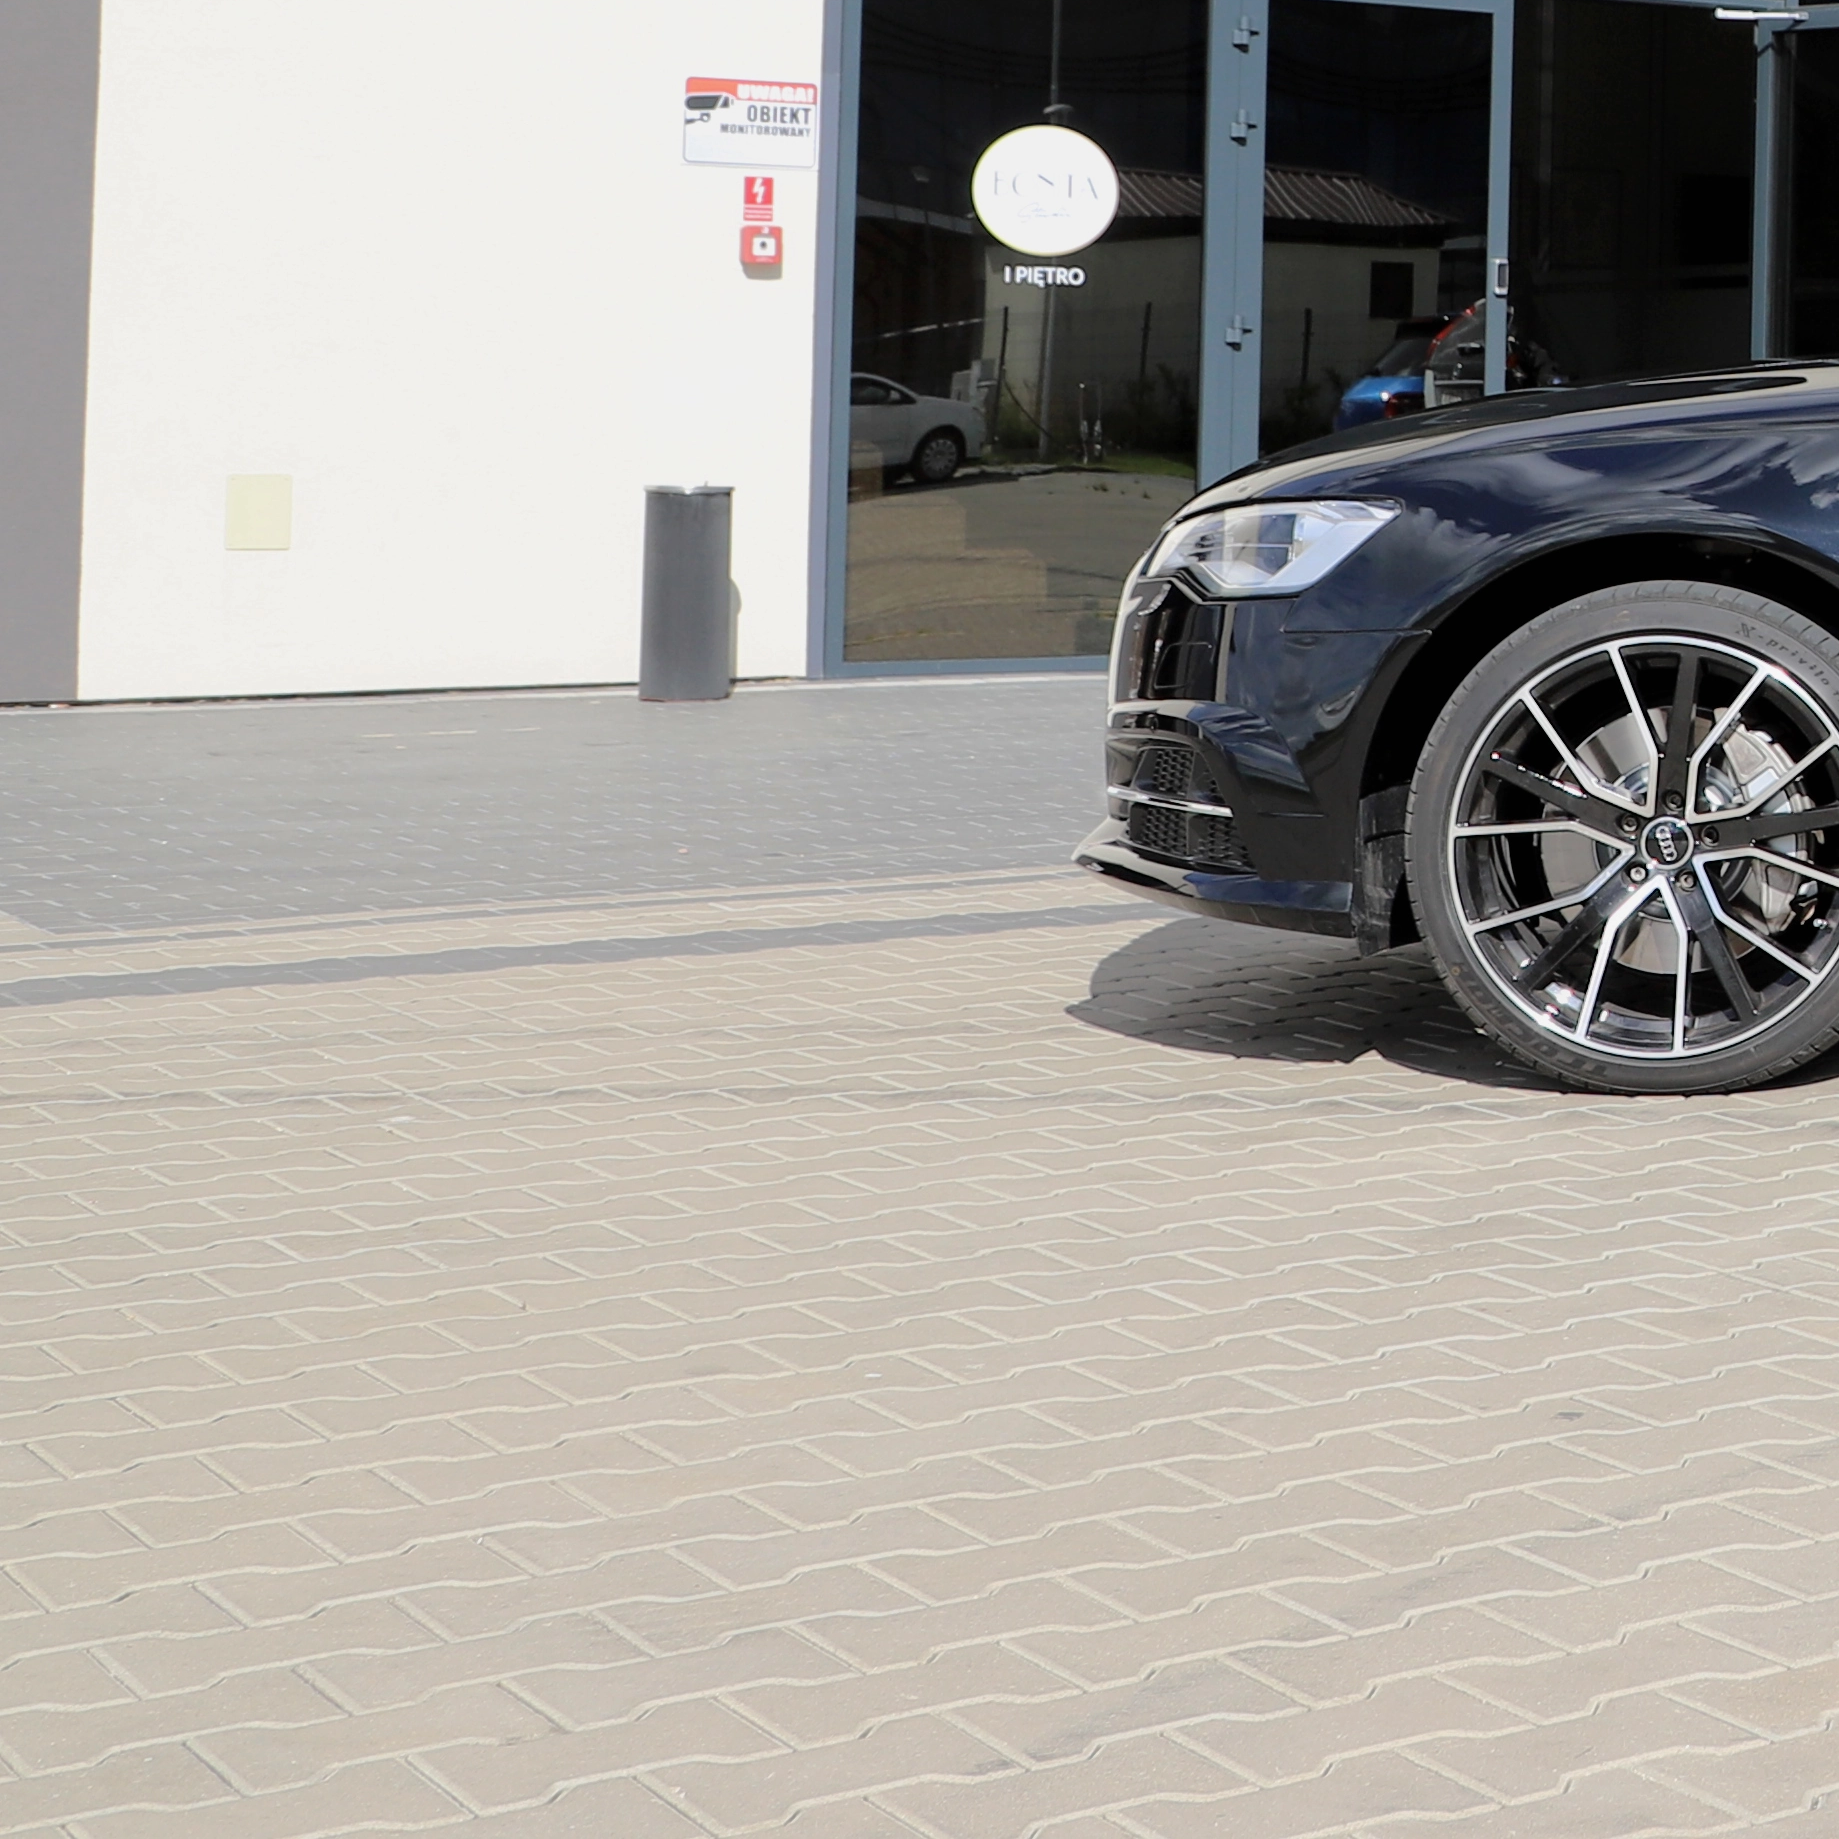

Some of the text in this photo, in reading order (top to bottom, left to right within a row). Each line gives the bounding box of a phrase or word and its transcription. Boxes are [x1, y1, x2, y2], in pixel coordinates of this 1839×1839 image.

[737, 83, 815, 103] UWAGA!
[747, 104, 812, 125] OBIEKT
[720, 123, 812, 138] MONITOROWANY
[1015, 265, 1087, 289] PIĘTRO
[1735, 622, 1830, 686] X-privilo
